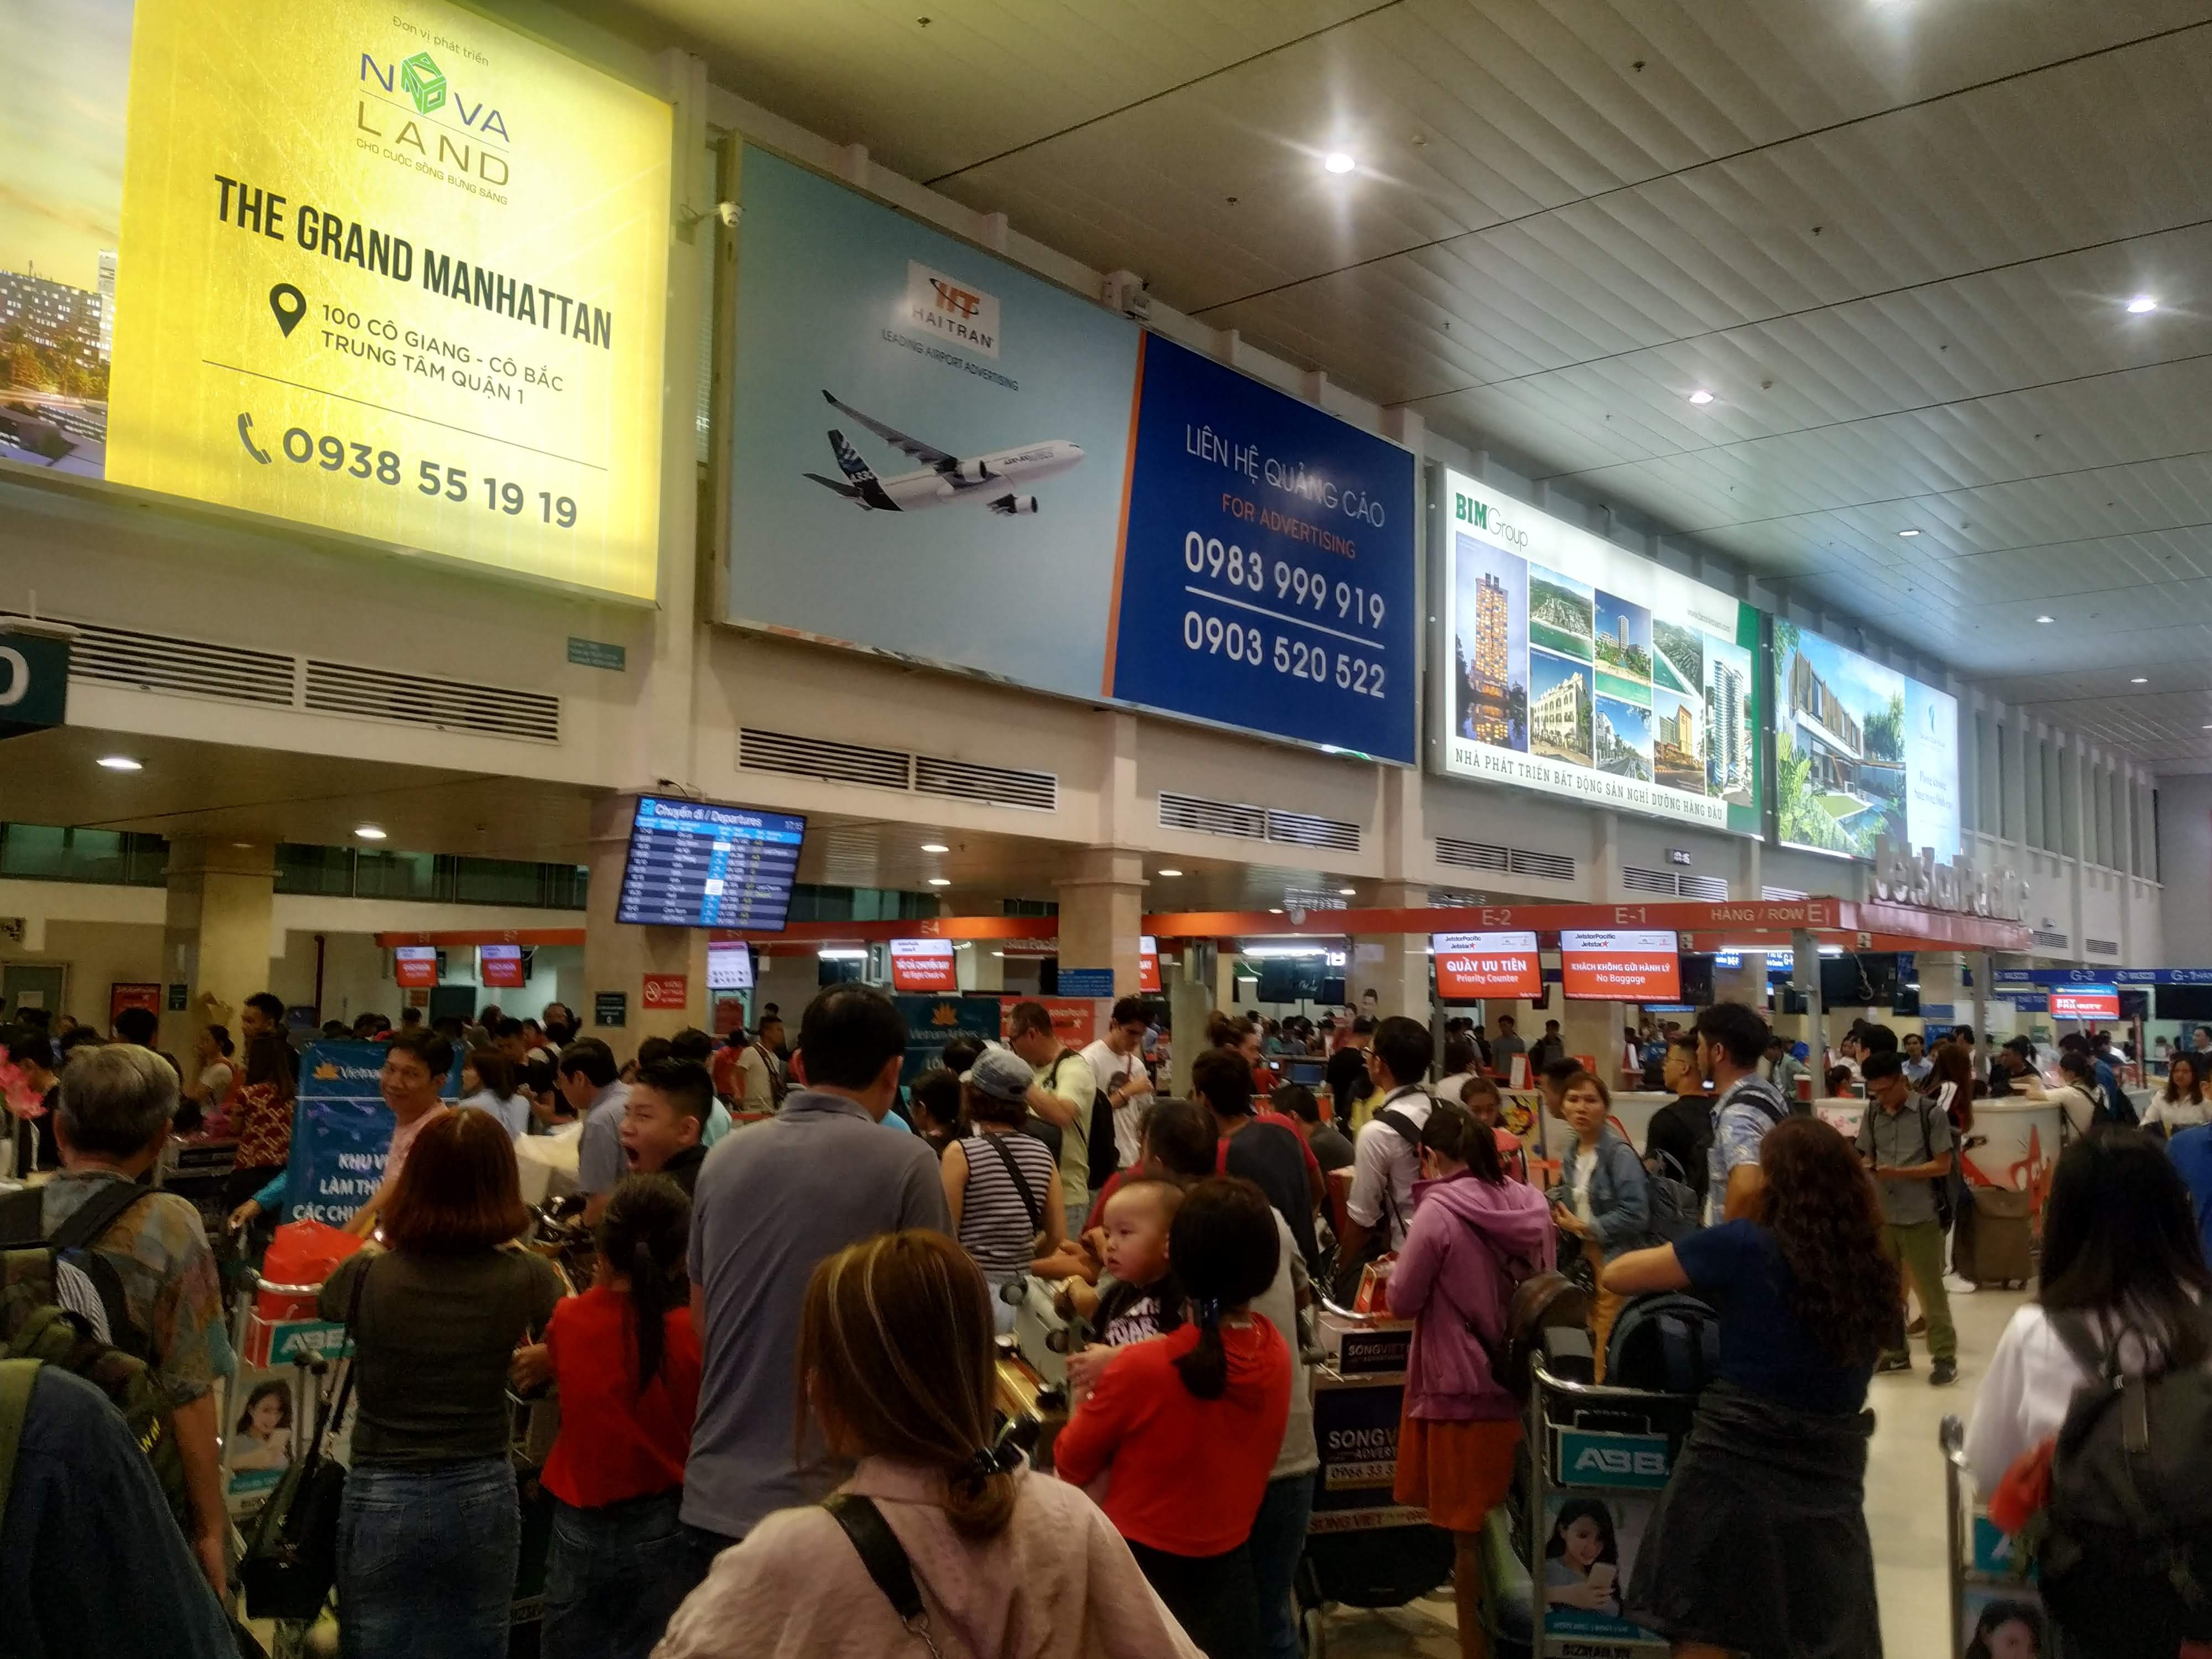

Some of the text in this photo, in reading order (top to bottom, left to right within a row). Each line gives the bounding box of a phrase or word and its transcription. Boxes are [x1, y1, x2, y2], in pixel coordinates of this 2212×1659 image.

[420, 30, 430, 44] vị
[434, 33, 461, 54] phát
[463, 46, 489, 67] triển
[358, 100, 509, 186] LAND
[357, 138, 379, 155] CHO
[383, 148, 413, 168] CUỘC
[479, 189, 508, 205] SÁNG
[215, 174, 612, 351] THE GRAND MANHATTAN
[322, 303, 361, 331] 100
[367, 315, 400, 341] CÔ
[405, 324, 471, 363] GIANG
[489, 345, 518, 378] CÔ
[525, 355, 564, 393] BẮC
[882, 328, 1019, 392] LEADING AIRPORT ADVERTISING
[321, 331, 524, 405] TRUNG TÂM QUẬN 1
[283, 427, 577, 530] 0938 55 19 19
[1186, 424, 1385, 528] LIÊN HỆ QUẢNG CÁO
[1222, 493, 1356, 560] FOR ADVERTISING
[1185, 530, 1384, 630] 0983 999 919
[1184, 611, 1385, 698] 0903 520 522
[1455, 748, 1480, 768] NHÀ
[1485, 755, 1514, 775] PHÁT
[1519, 761, 1550, 782] TRIỂN
[1554, 769, 1573, 787] BẤT
[1576, 775, 1603, 795] ĐỘNG
[1683, 797, 1705, 817] HÀNG
[1707, 802, 1723, 821] ĐẦU
[655, 803, 692, 820] Chuyến
[711, 811, 763, 828] Departures
[1482, 910, 1512, 925] E-2
[1615, 907, 1646, 924] E-1
[1711, 906, 1755, 921] HÀNG
[1767, 909, 1805, 921] ROW
[1807, 904, 1823, 922] E
[1447, 956, 1479, 972] QUẦY
[1501, 957, 1527, 972] TIÊN
[1456, 974, 1520, 985] Priority Counter
[1571, 962, 1596, 971] KHÁCH
[1598, 962, 1624, 972] KHÔNG
[1639, 962, 1661, 972] HÀNH
[1596, 974, 1646, 985] No Baggage
[2069, 969, 2096, 982] G-2
[338, 1154, 372, 1171] KHU
[320, 1175, 354, 1196] LÀM
[292, 1201, 326, 1222] CÁC
